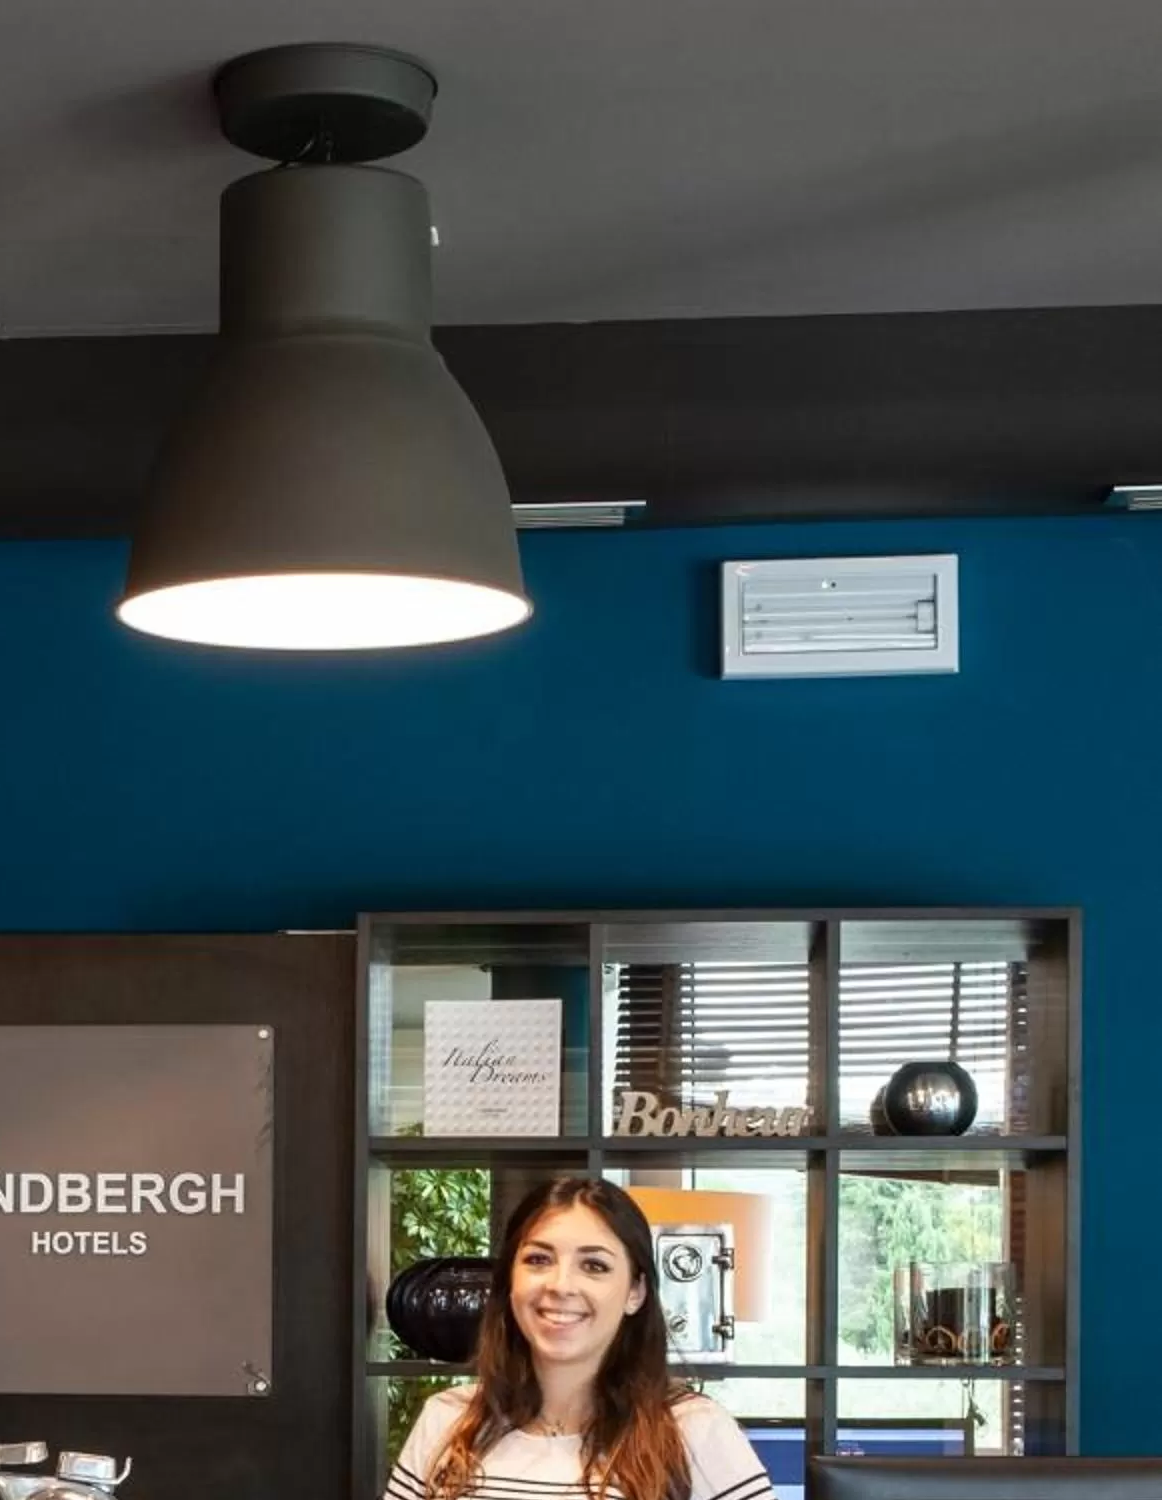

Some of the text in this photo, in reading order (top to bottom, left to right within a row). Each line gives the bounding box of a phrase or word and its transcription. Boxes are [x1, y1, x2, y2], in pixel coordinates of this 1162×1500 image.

[441, 1039, 516, 1067] Italian
[469, 1065, 547, 1084] Dreams
[612, 1089, 814, 1137] Bonheur
[31, 1231, 147, 1254] HOTELS
